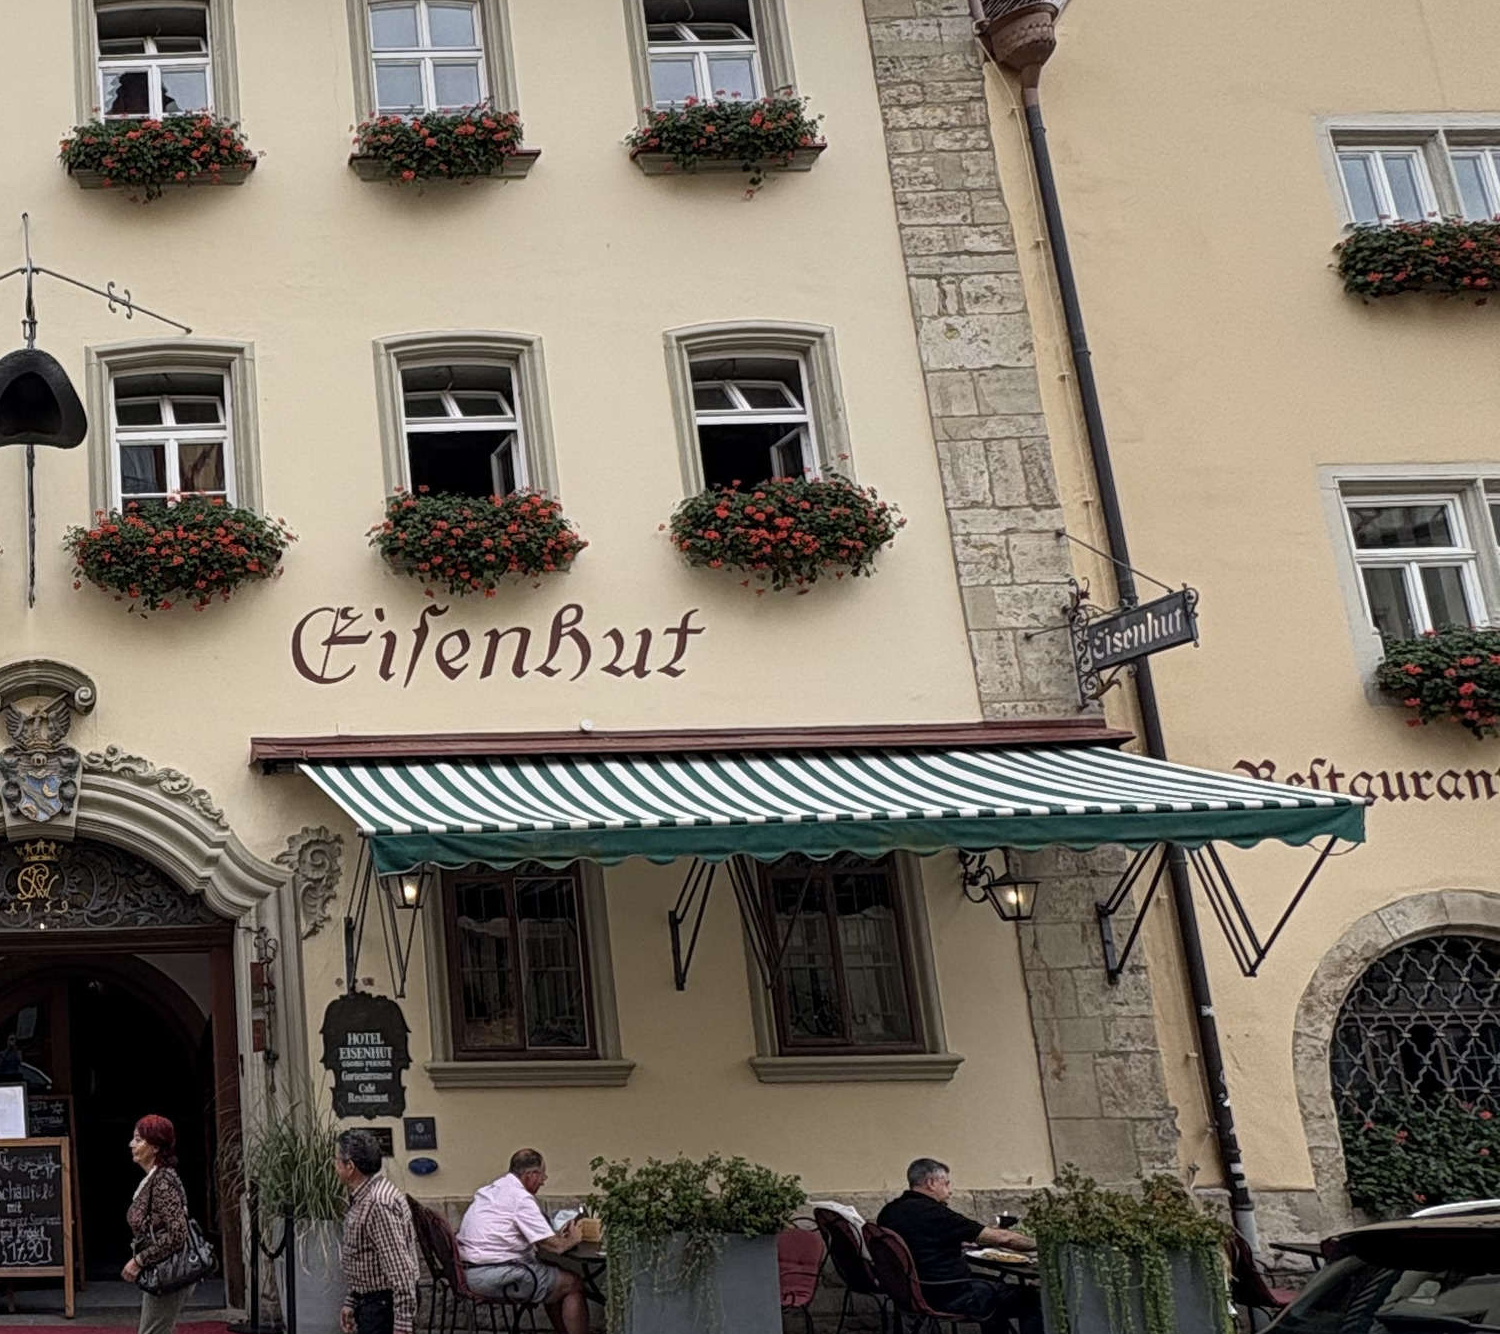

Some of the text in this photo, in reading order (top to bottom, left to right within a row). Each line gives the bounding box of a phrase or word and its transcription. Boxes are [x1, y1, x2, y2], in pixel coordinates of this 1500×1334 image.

[1092, 606, 1182, 660] Eisenhut
[347, 1032, 384, 1045] HOTEL
[339, 1046, 393, 1060] EISENHUT
[358, 1082, 376, 1094] Café
[6, 1201, 23, 1214] mit
[6, 1240, 45, 1261] 17,90
